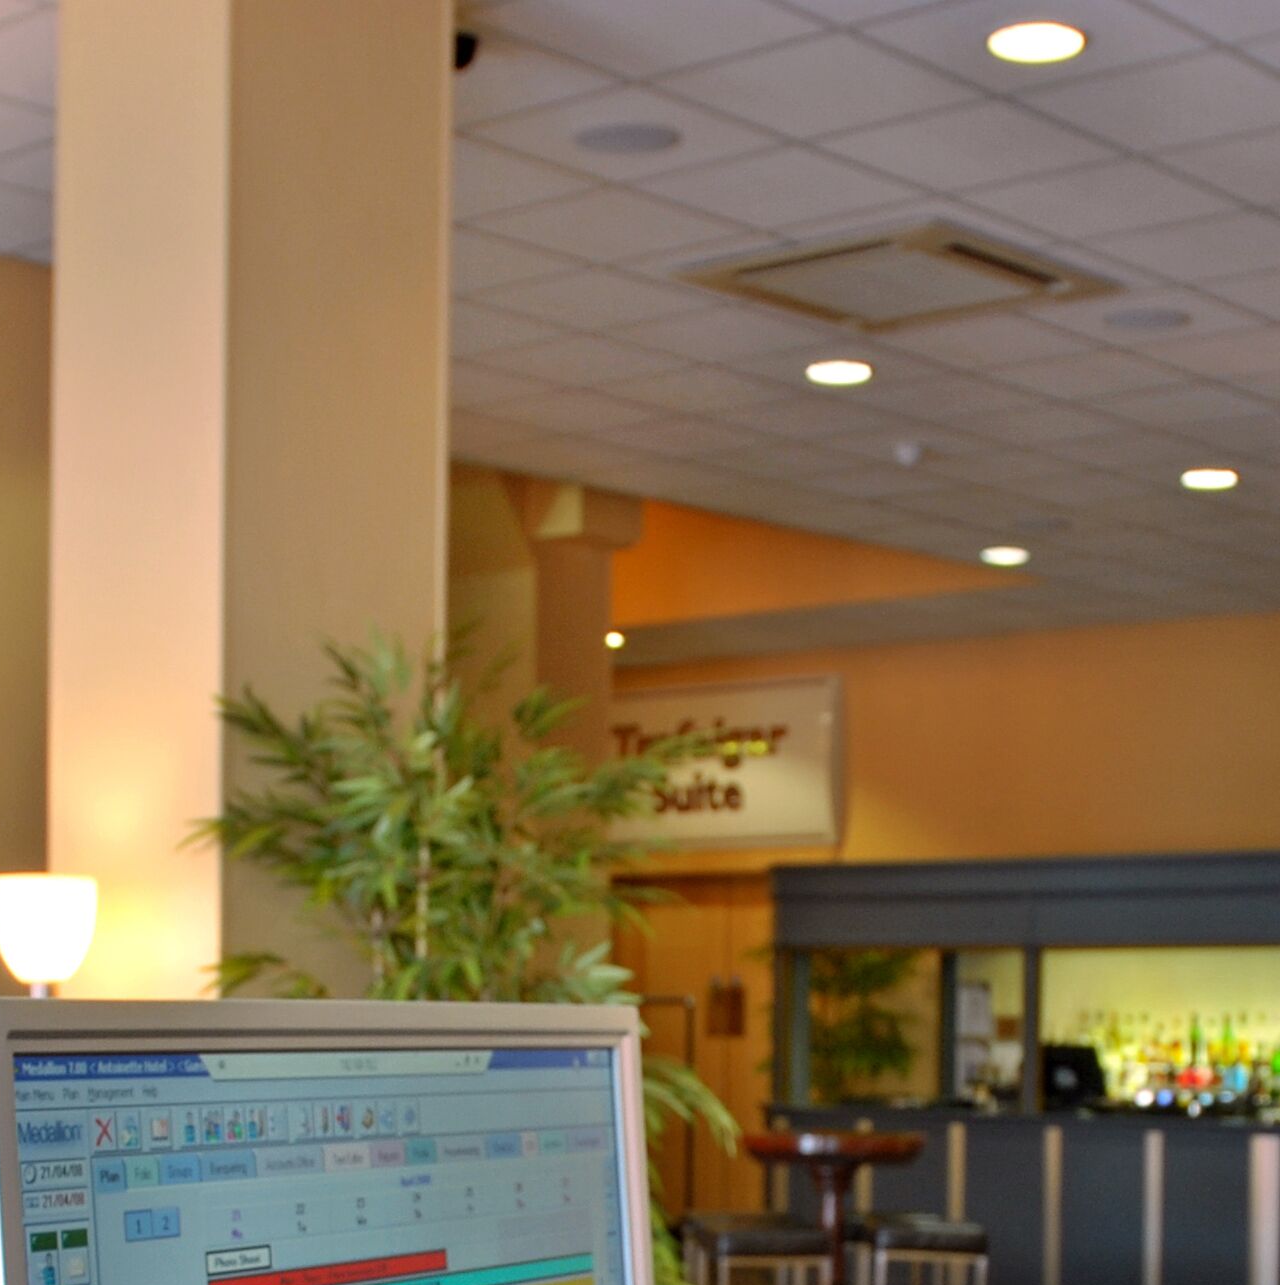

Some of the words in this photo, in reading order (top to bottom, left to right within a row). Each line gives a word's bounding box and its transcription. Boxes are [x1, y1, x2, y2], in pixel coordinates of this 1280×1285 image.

[22, 1062, 65, 1074] Medallion
[145, 1060, 166, 1071] Hotel
[87, 1086, 134, 1101] Management
[18, 1119, 81, 1143] Medallion
[99, 1167, 119, 1183] Plan
